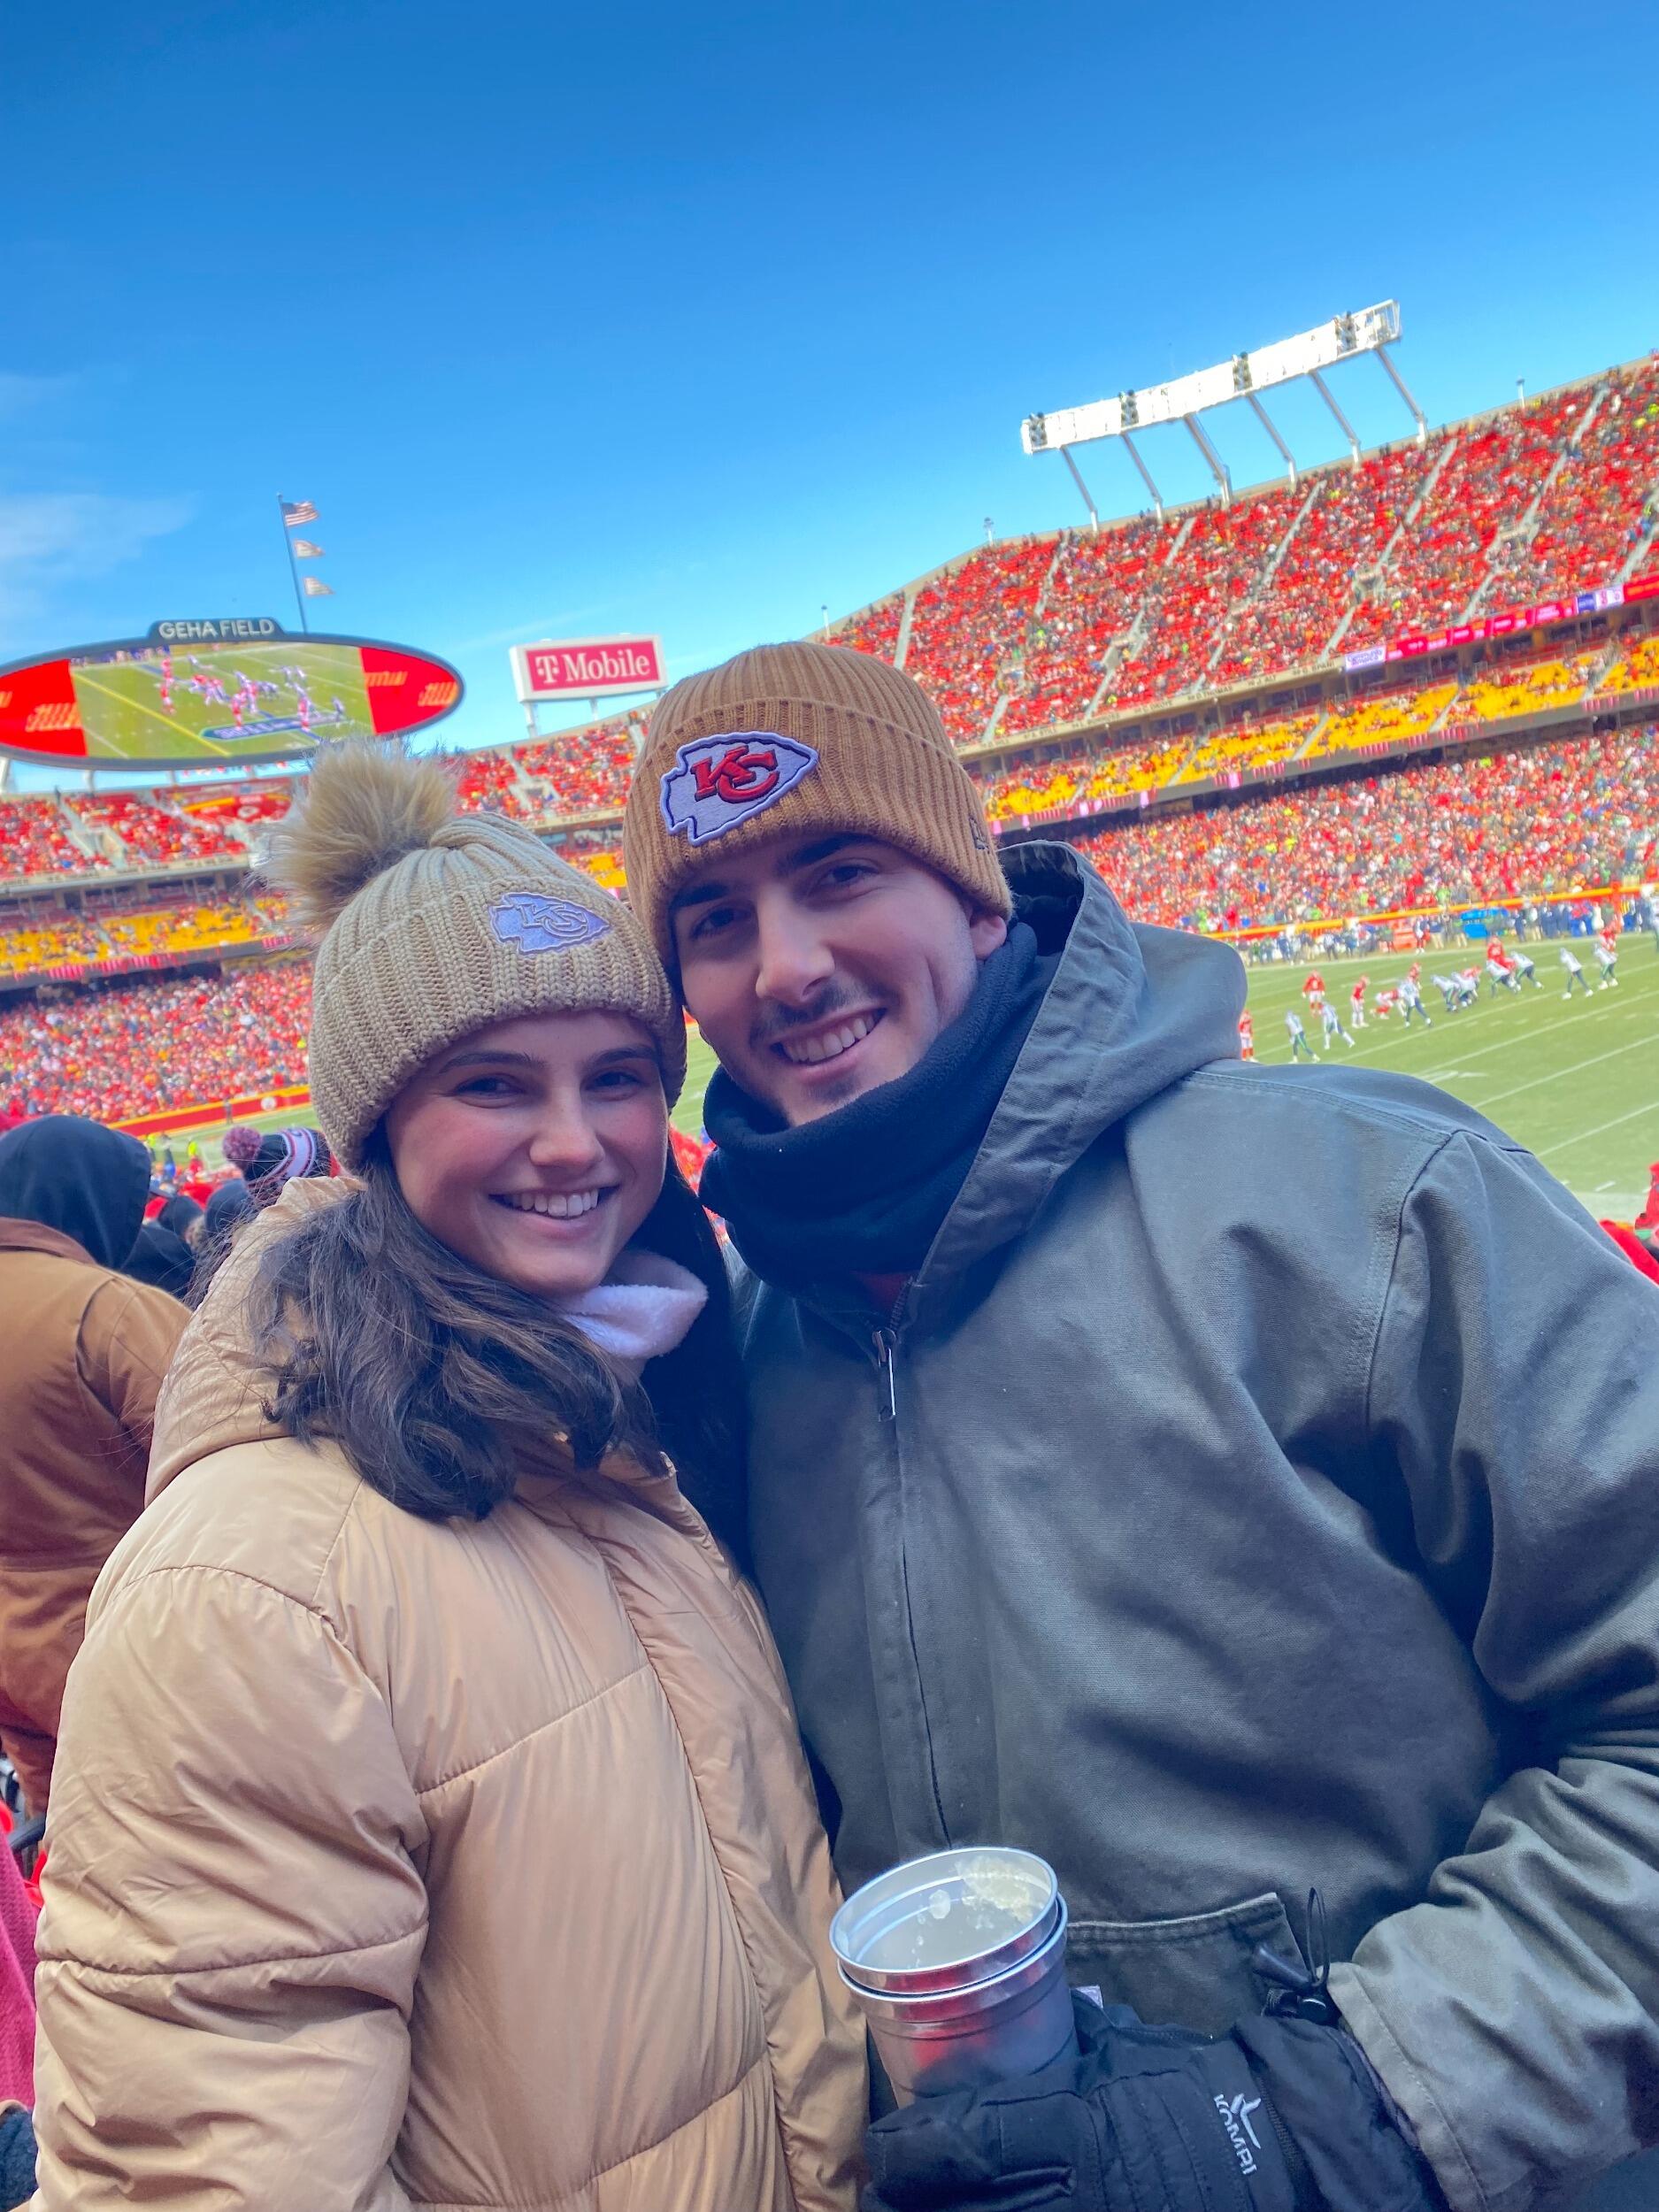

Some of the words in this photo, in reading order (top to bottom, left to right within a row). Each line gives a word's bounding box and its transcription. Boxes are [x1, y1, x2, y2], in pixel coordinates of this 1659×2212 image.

[158, 621, 218, 640] GEHA
[219, 618, 275, 638] FIELD
[690, 745, 780, 803] KC
[516, 902, 588, 938] KC
